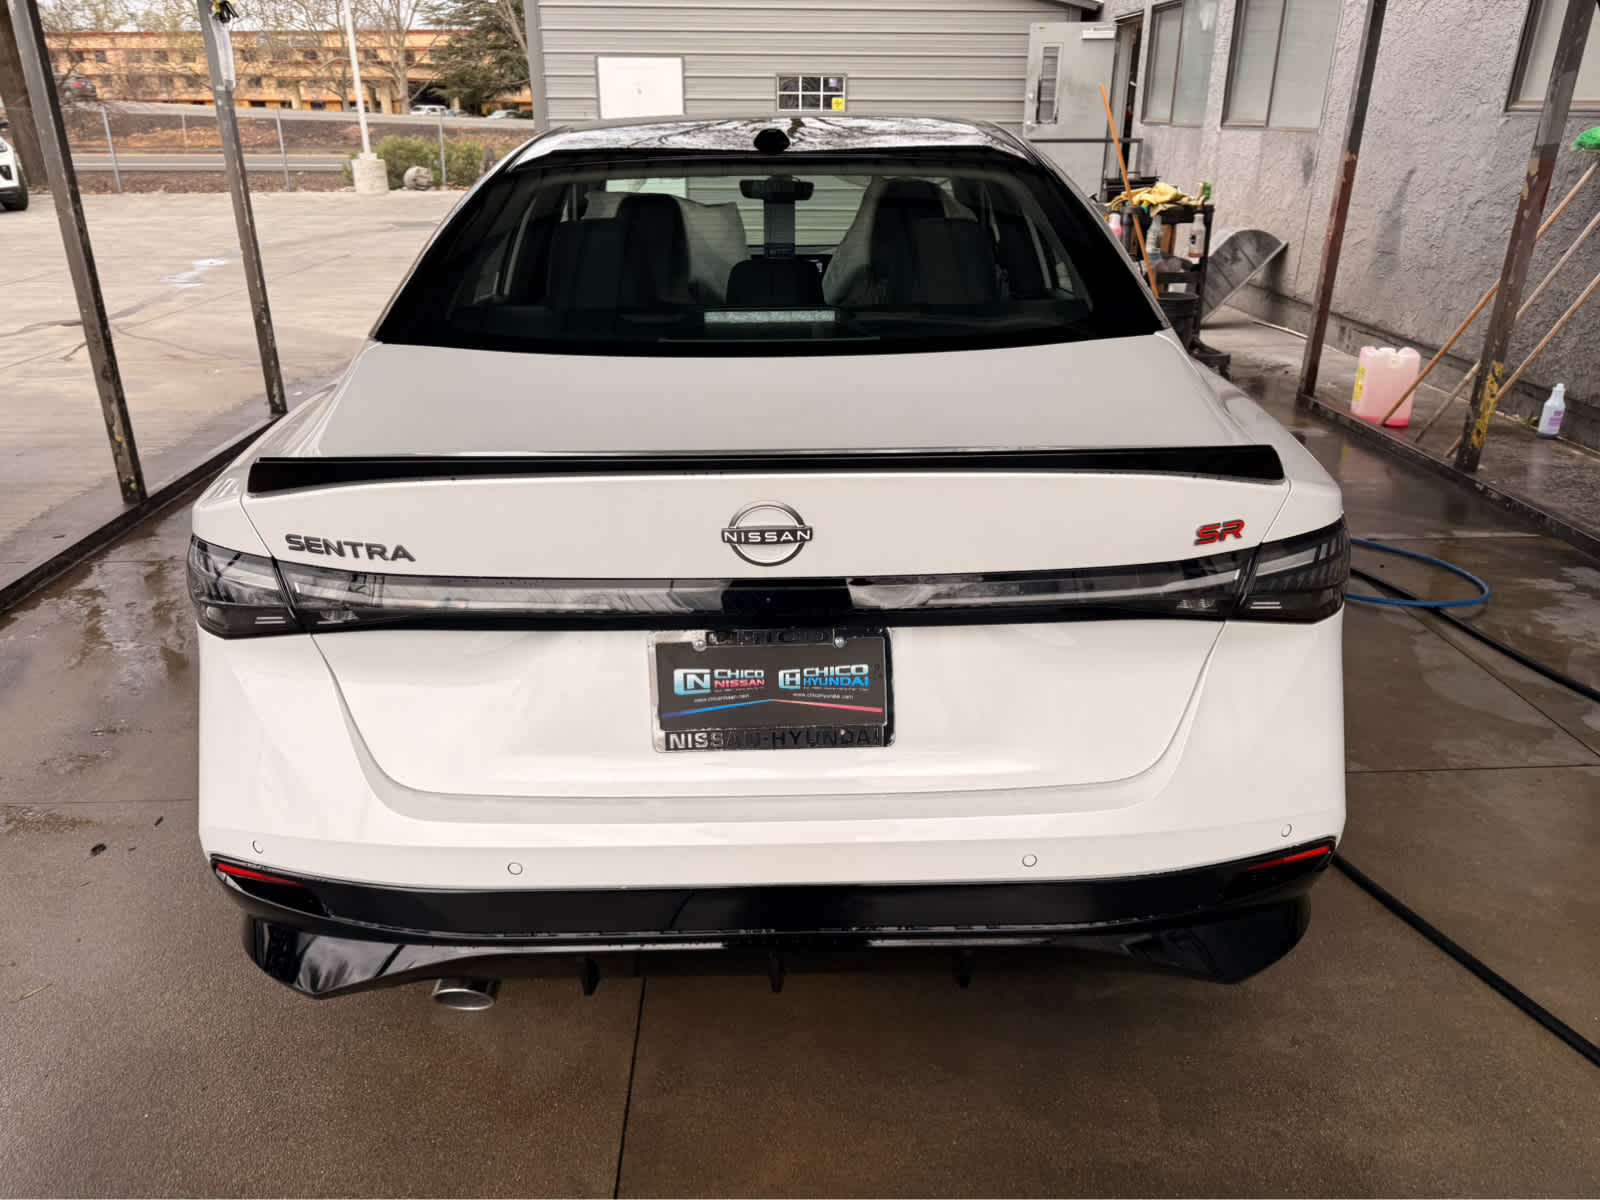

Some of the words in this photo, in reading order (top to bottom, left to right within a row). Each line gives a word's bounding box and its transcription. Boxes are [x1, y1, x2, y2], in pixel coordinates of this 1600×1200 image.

[724, 530, 810, 542] NISSAN
[1193, 519, 1245, 546] SR
[285, 533, 416, 562] SENTRA
[714, 669, 765, 679] CHICO
[803, 664, 869, 677] CHICO
[714, 679, 765, 688] NISSAN
[803, 676, 870, 688] HYUNDAI
